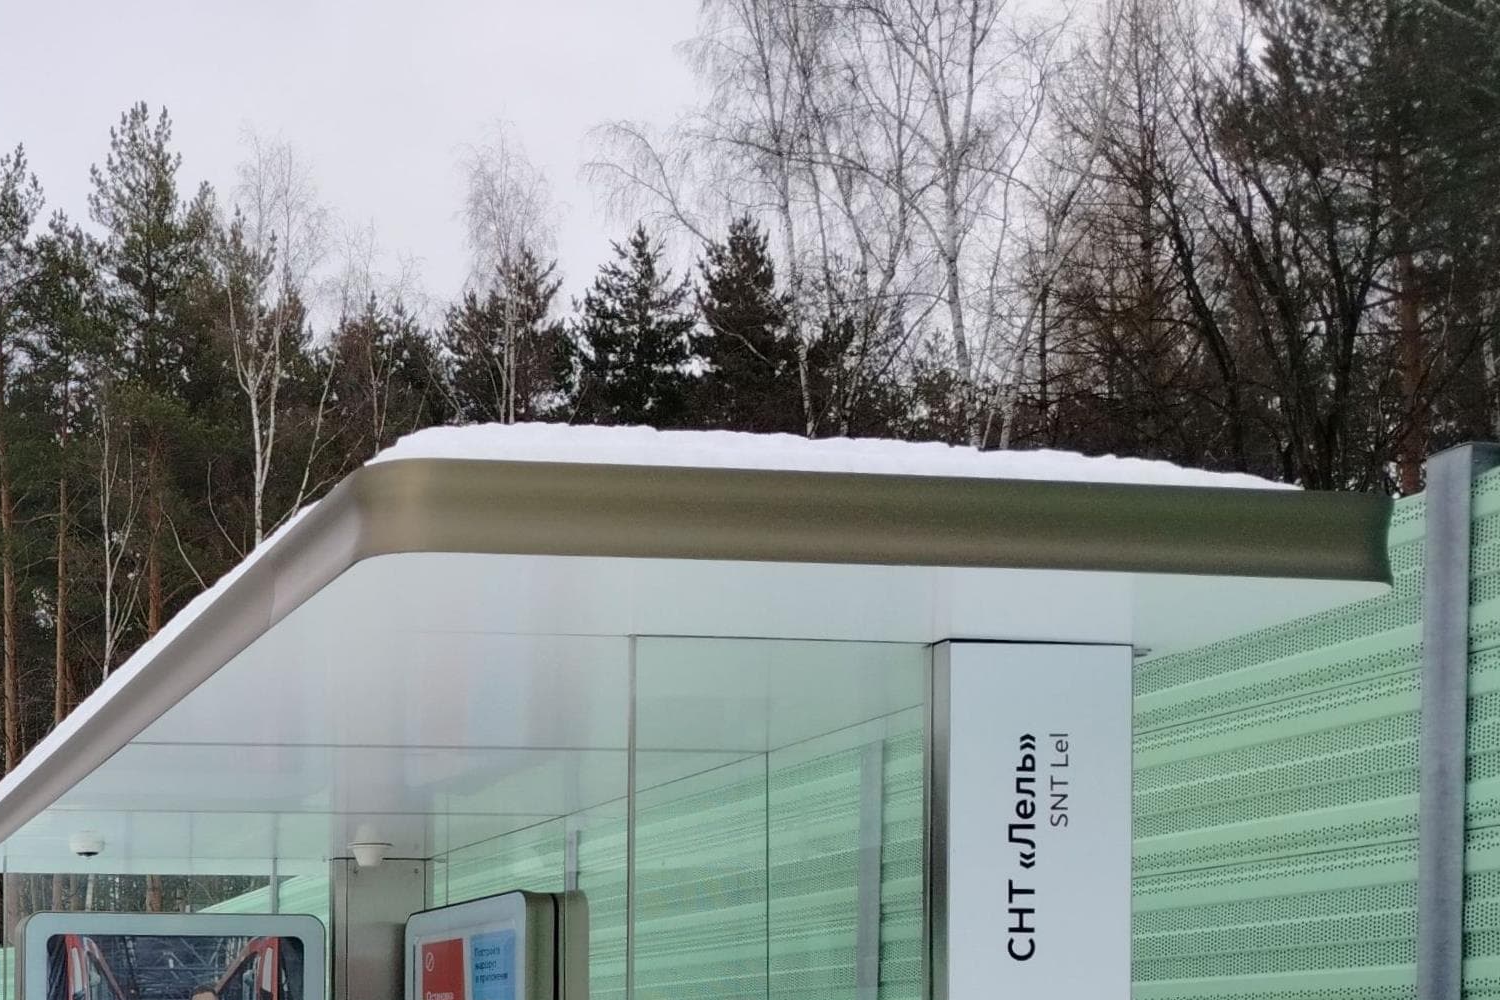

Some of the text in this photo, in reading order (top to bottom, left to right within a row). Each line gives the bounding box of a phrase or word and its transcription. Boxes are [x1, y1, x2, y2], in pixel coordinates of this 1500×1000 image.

[1007, 733, 1037, 962] СНТ «Лель»
[1049, 733, 1070, 828] SNT Lel
